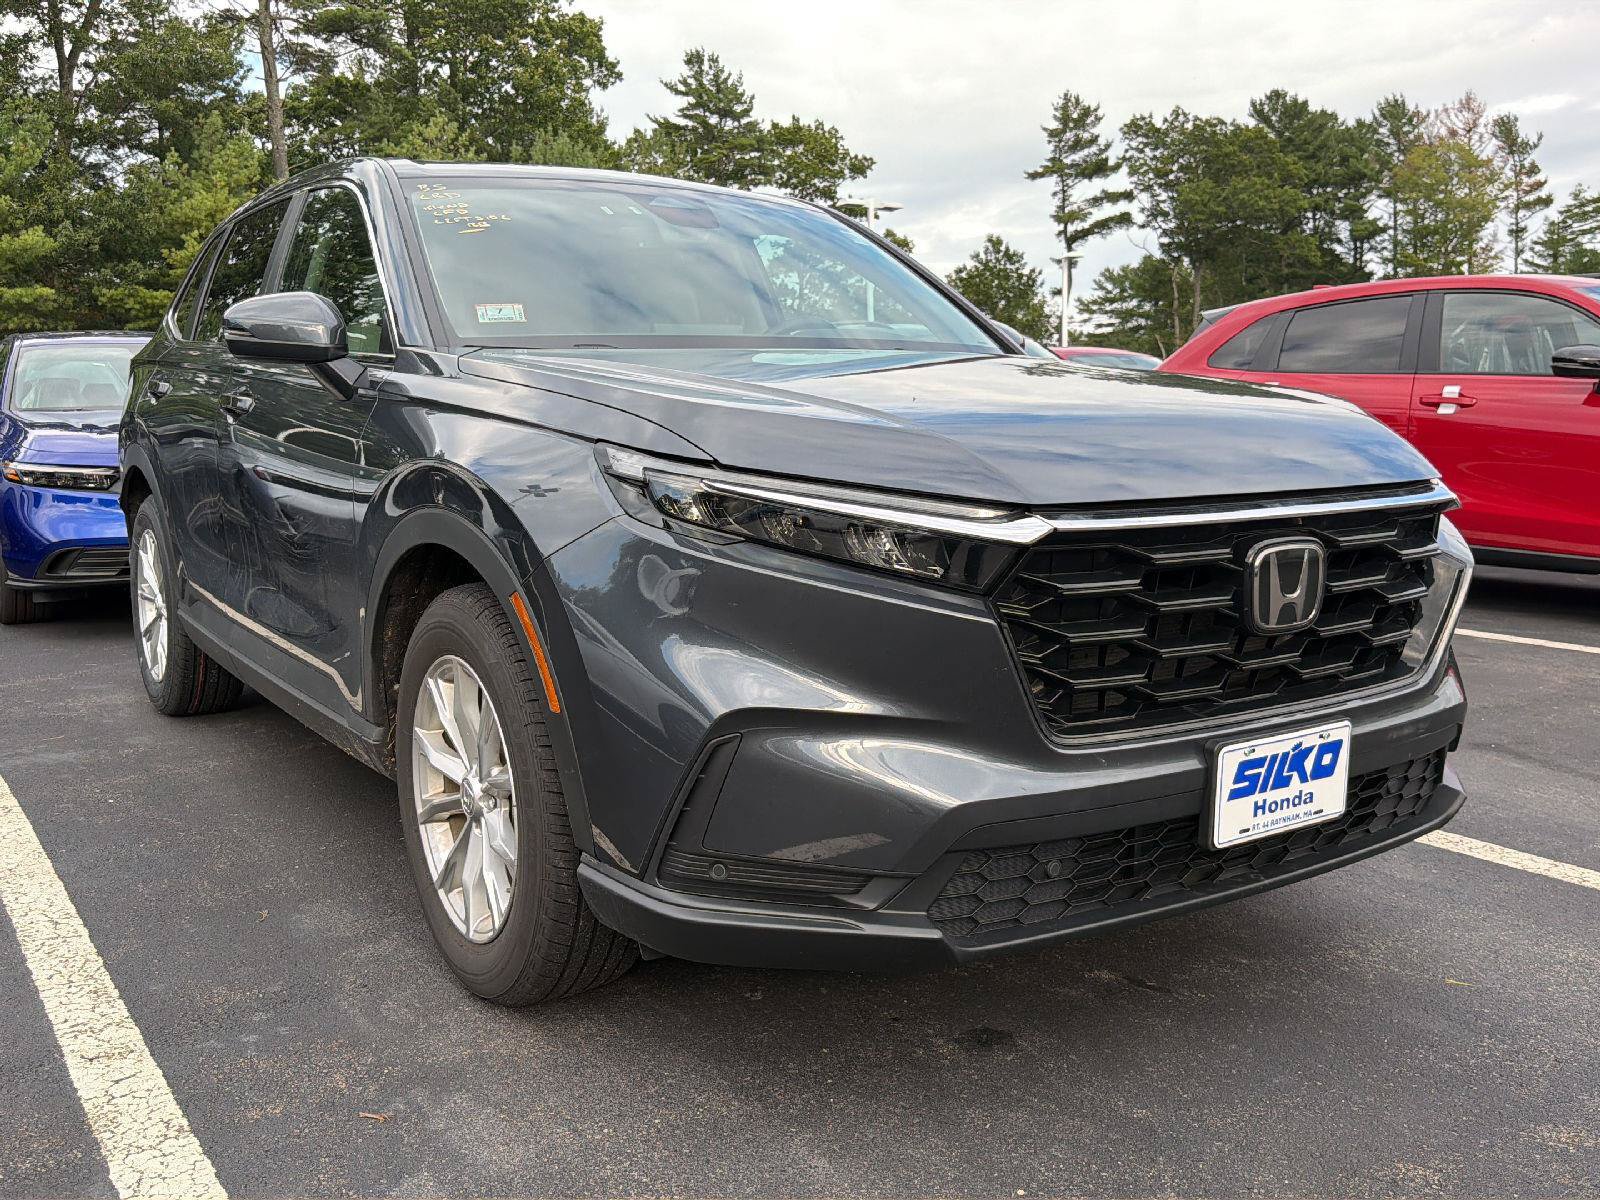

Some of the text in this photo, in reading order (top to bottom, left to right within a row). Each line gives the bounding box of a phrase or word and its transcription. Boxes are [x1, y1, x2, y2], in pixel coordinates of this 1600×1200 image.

[1227, 738, 1344, 802] SILKO
[1253, 790, 1314, 818] Honda
[1262, 820, 1269, 828] 44
[1303, 809, 1313, 819] MA
